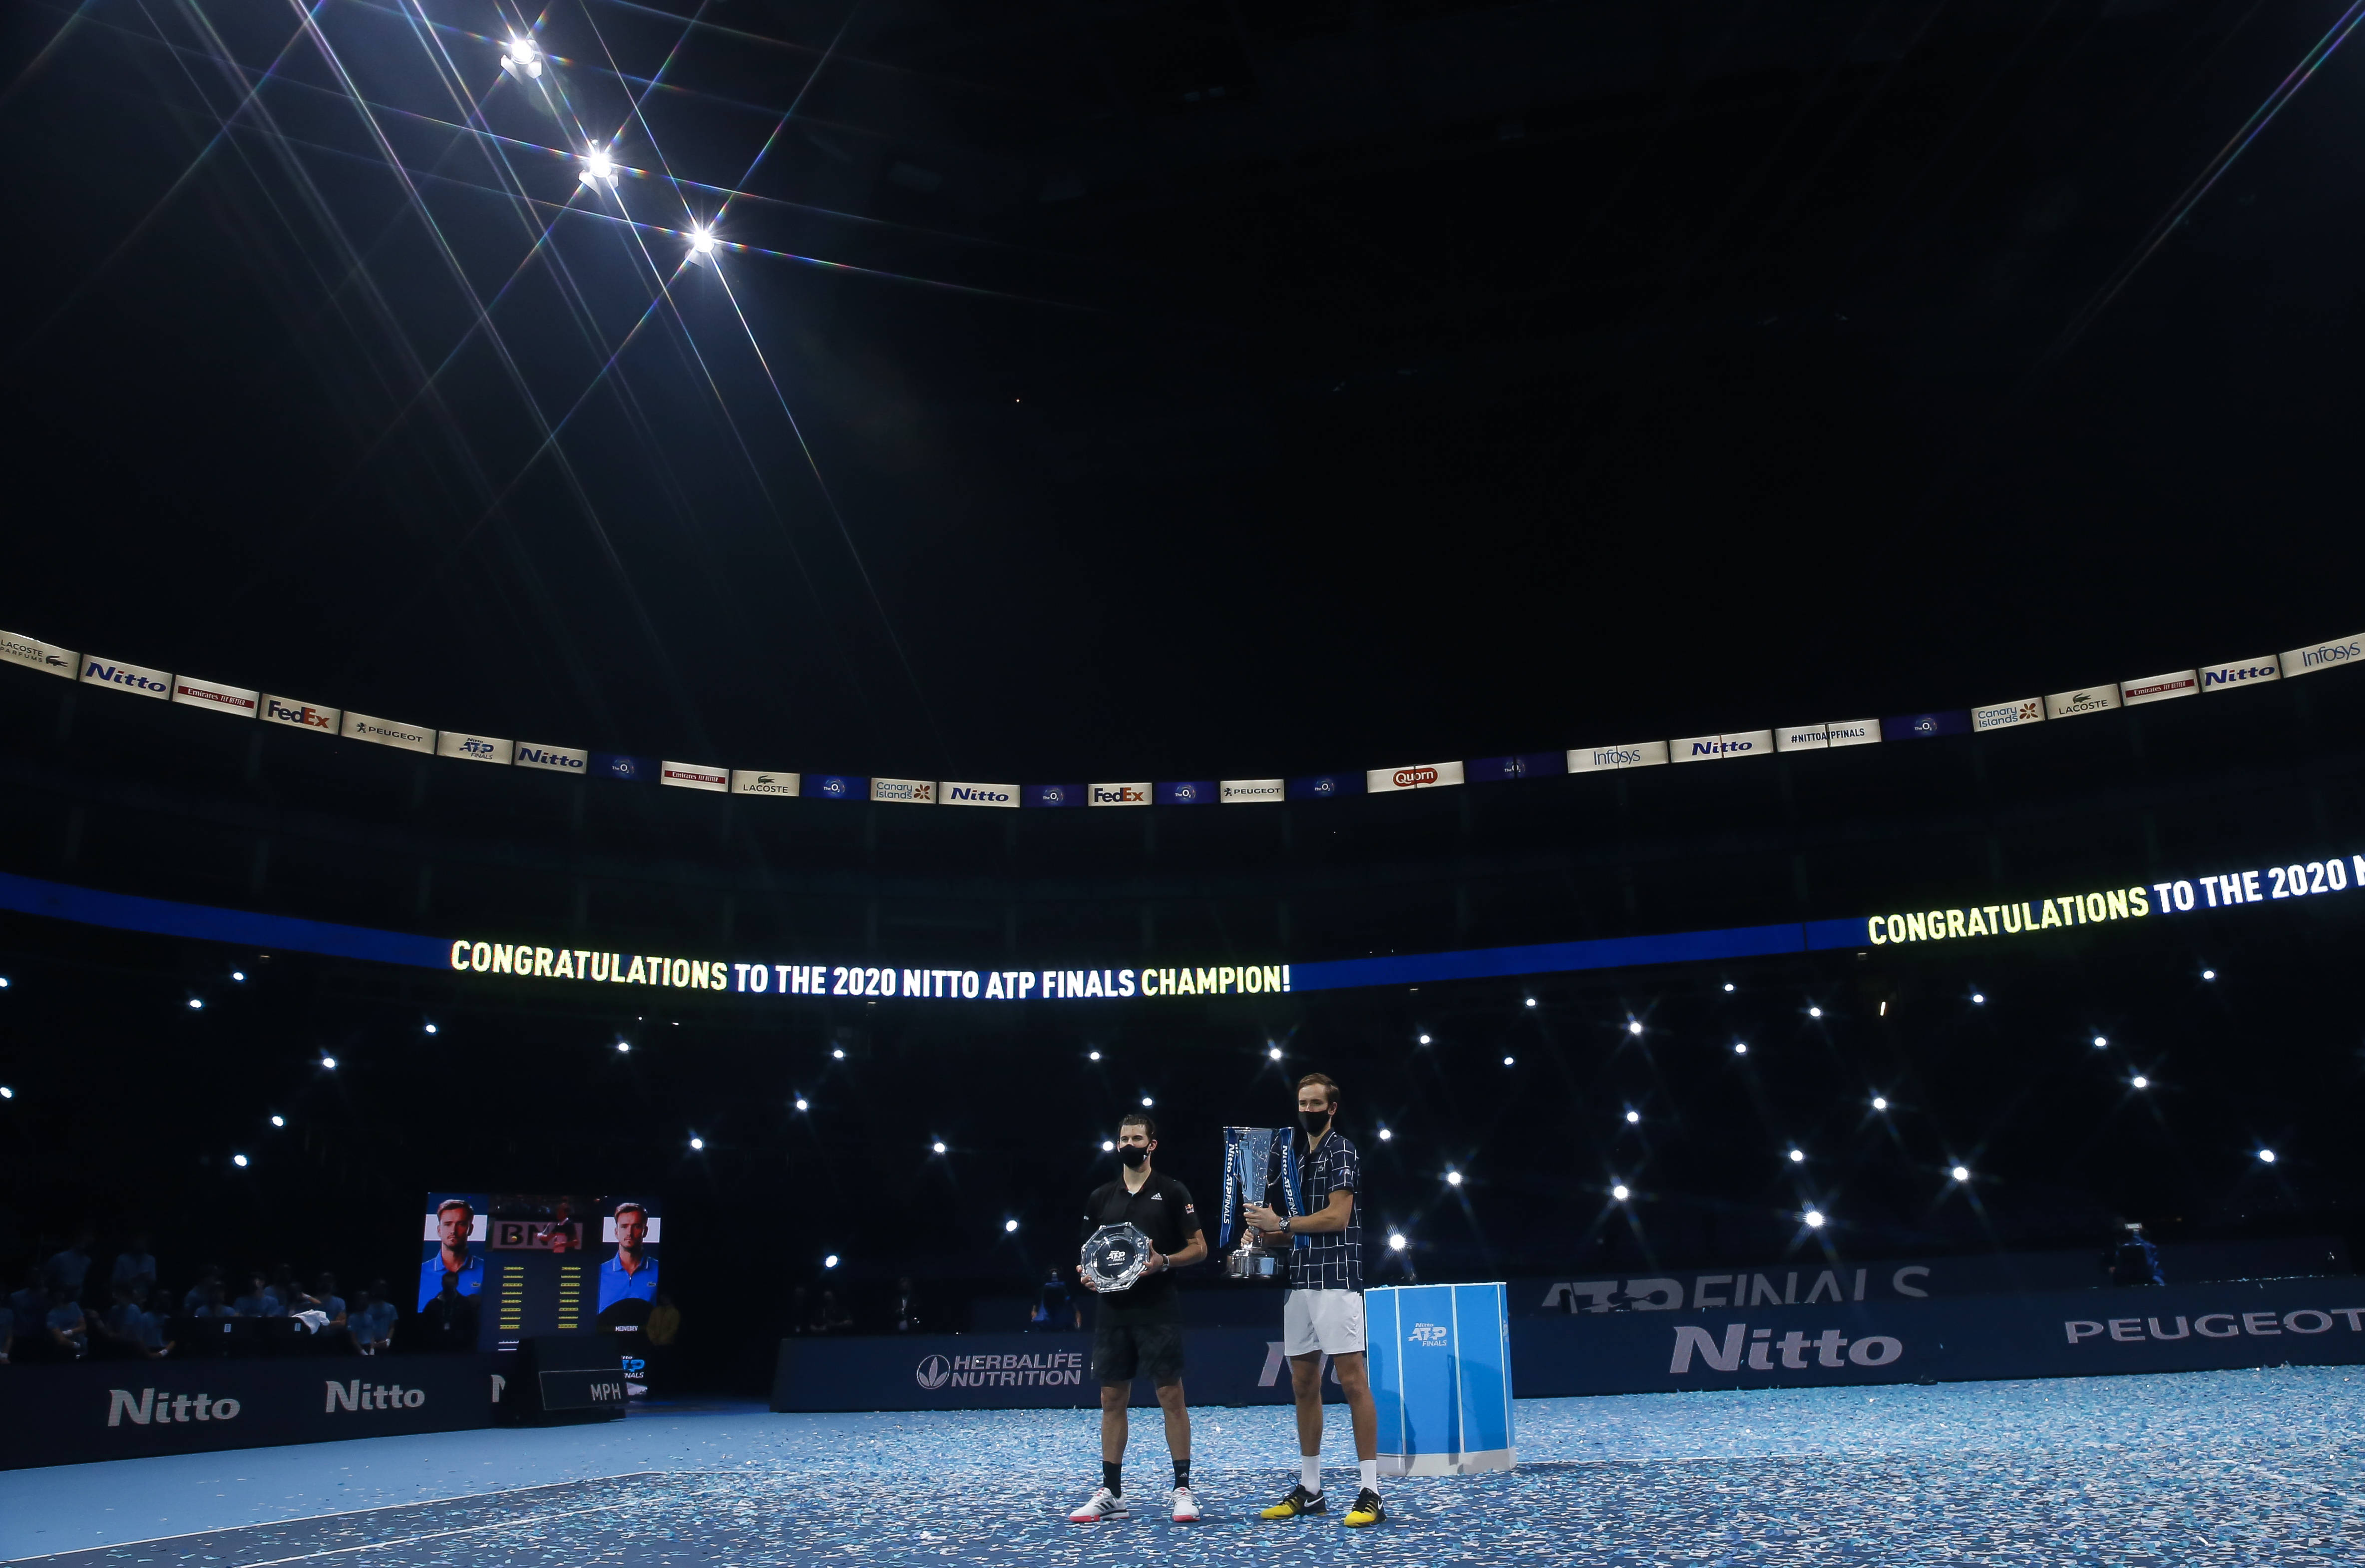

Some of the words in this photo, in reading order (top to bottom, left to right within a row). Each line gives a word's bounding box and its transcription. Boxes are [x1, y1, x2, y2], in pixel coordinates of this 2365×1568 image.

[0, 647, 42, 662] PARFUMS
[1, 640, 43, 657] LACOSTE
[2302, 642, 2361, 667] Infosys
[85, 662, 166, 692] Nitto
[2205, 666, 2275, 686] Nitto
[188, 688, 218, 700] Emirates
[229, 697, 245, 706] BETTER
[2134, 687, 2162, 695] Emirates
[268, 700, 330, 729] FedEx
[1978, 707, 2017, 719] Canary
[2058, 700, 2108, 715] LACOSTE
[1979, 715, 2018, 728] Islands
[369, 726, 423, 742] PEUGEOT
[459, 742, 494, 753] ATP
[1691, 741, 1753, 756] Nitto
[517, 748, 583, 769] Nitto
[1593, 750, 1641, 766] Infosys
[1396, 772, 1434, 784] Quorn
[743, 784, 788, 793] LACOSTE
[876, 782, 912, 794] Canary
[876, 790, 912, 799] Islands
[951, 787, 1009, 802] Nitto
[1094, 787, 1144, 802] FedEx
[1868, 886, 2149, 945] CONGRATULATIONS
[2153, 879, 2195, 913] TO
[2199, 870, 2264, 909] THE
[2267, 859, 2347, 900] 2020
[451, 939, 728, 991] CONGRATULATIONS
[735, 963, 768, 993] TO
[776, 965, 826, 995] THE
[833, 967, 896, 997] 2020
[903, 969, 979, 998] NITTO
[985, 971, 1036, 999] ATP
[1043, 969, 1135, 998] FINALS
[1141, 964, 1291, 997] CHAMPION!
[1284, 1176, 1293, 1196] ATP
[1287, 1196, 1300, 1217] FINA
[1542, 1278, 1684, 1314] ATP
[1692, 1266, 1931, 1309] FINALS
[1407, 1327, 1447, 1341] ATP
[2065, 1308, 2365, 1343] PEUGEOT
[1669, 1323, 1903, 1374] Nitto
[622, 1359, 645, 1372] TP
[953, 1353, 1082, 1370] HERBALIFE
[951, 1370, 1081, 1387] NUTRITION
[326, 1379, 425, 1413] Nitto
[591, 1383, 621, 1401] MPH
[107, 1388, 241, 1427] Nitto
